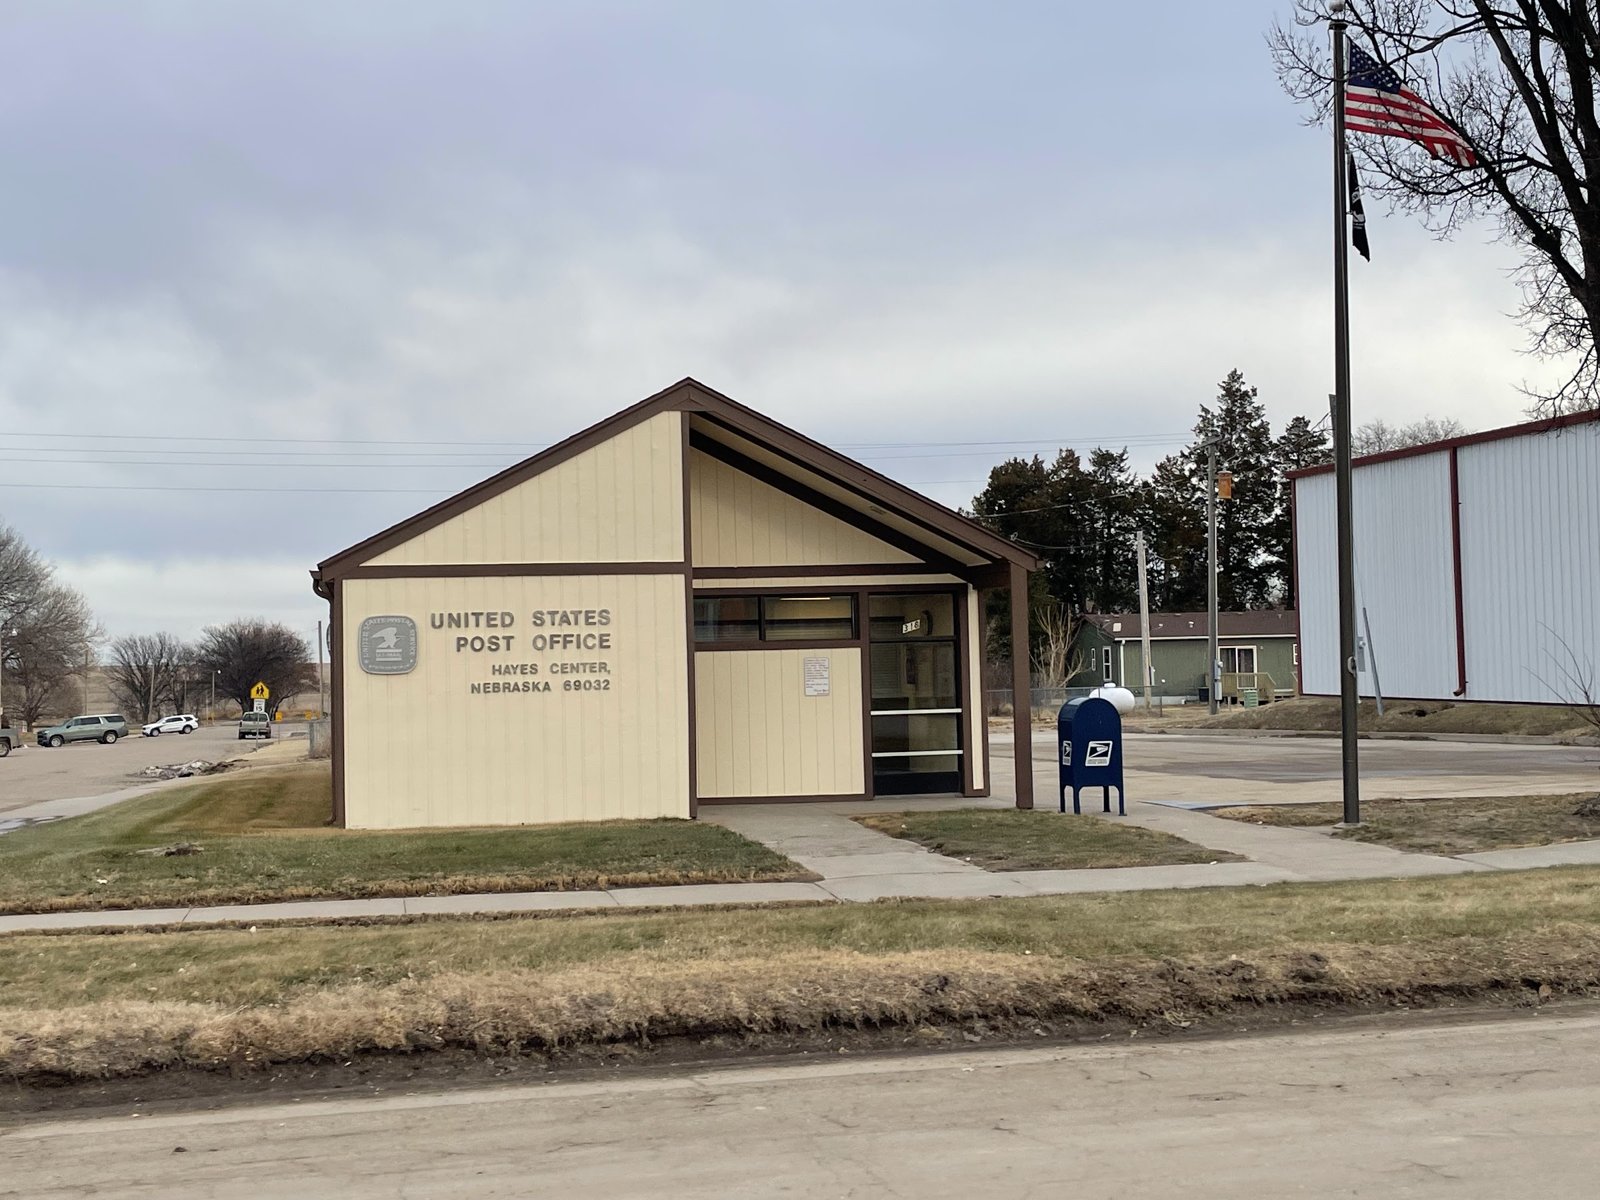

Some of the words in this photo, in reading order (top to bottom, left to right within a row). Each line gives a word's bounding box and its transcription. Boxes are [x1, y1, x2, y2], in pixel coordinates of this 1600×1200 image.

[431, 612, 514, 629] UNITED
[532, 609, 611, 627] STATES
[456, 635, 515, 652] POST
[532, 633, 611, 650] OFFICE
[492, 664, 539, 675] HAYES
[550, 662, 611, 675] CENTER,
[471, 681, 552, 694] NEBRASKA
[563, 679, 610, 691] 69032
